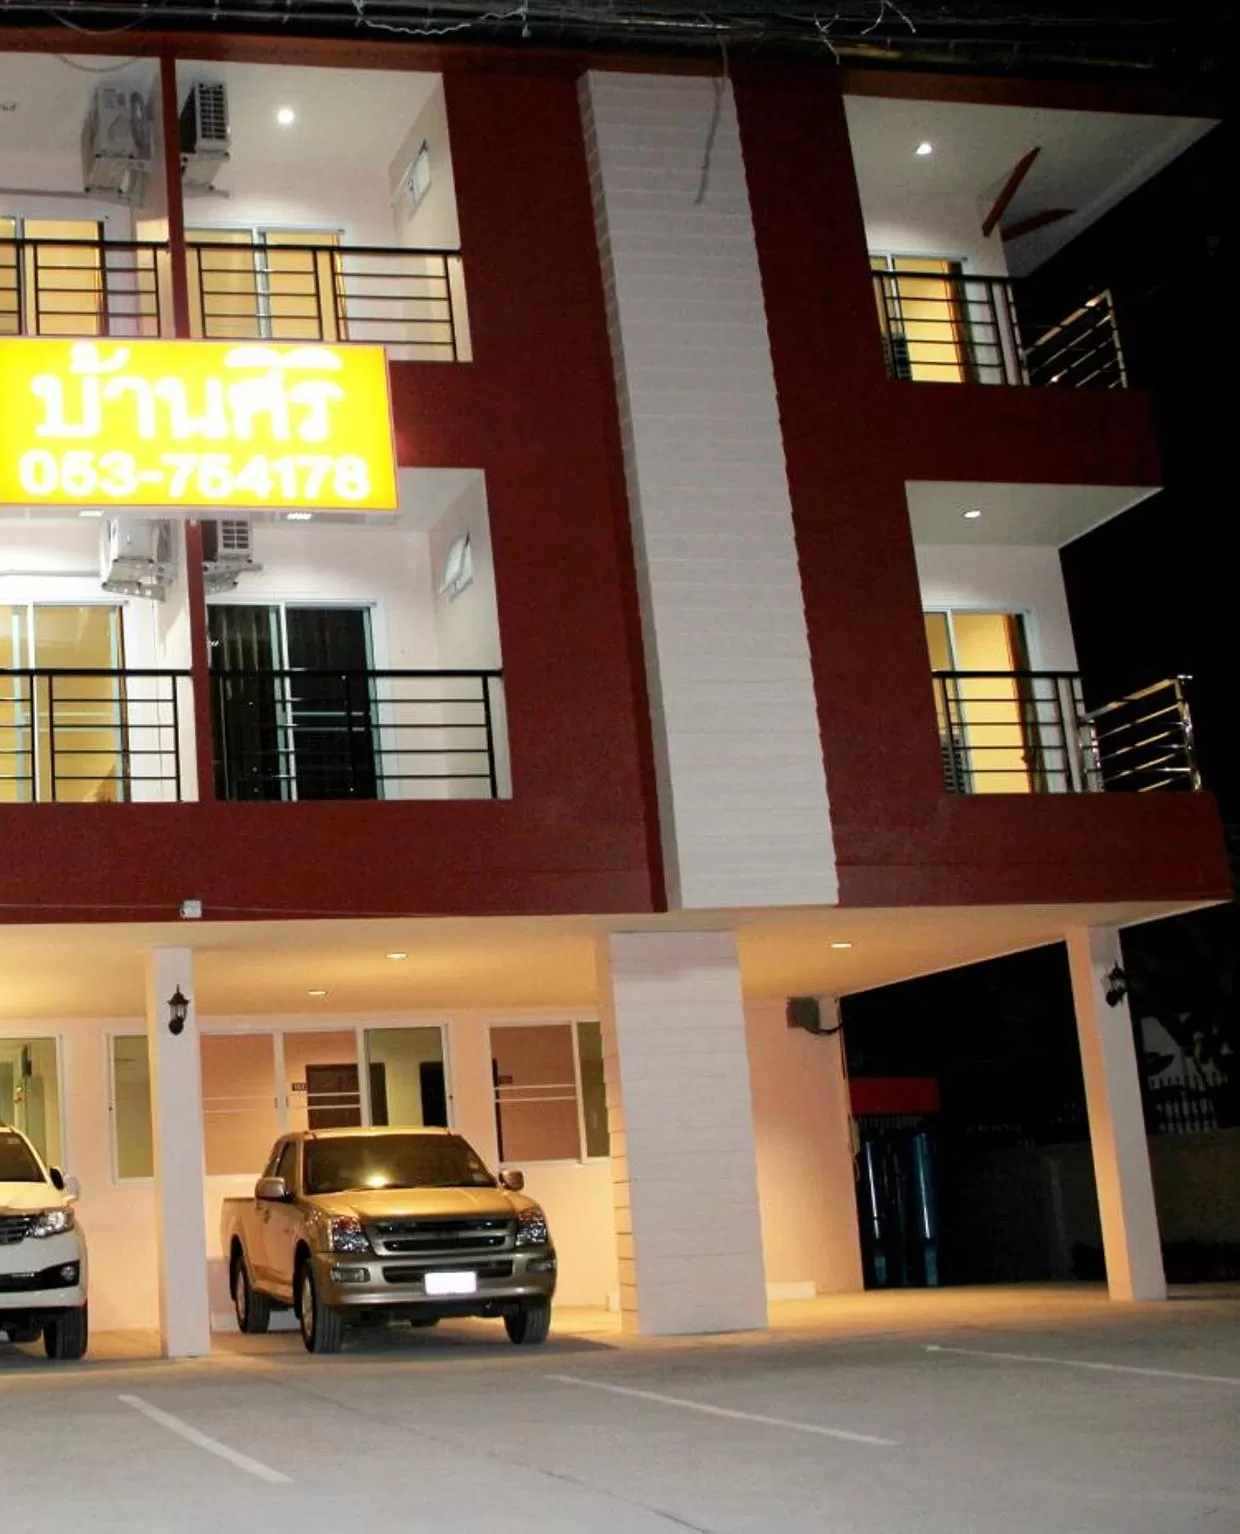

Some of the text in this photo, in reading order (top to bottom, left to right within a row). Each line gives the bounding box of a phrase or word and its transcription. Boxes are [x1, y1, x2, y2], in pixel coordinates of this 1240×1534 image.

[30, 341, 345, 443] บ้านศิริ
[18, 448, 372, 501] 053-754178
